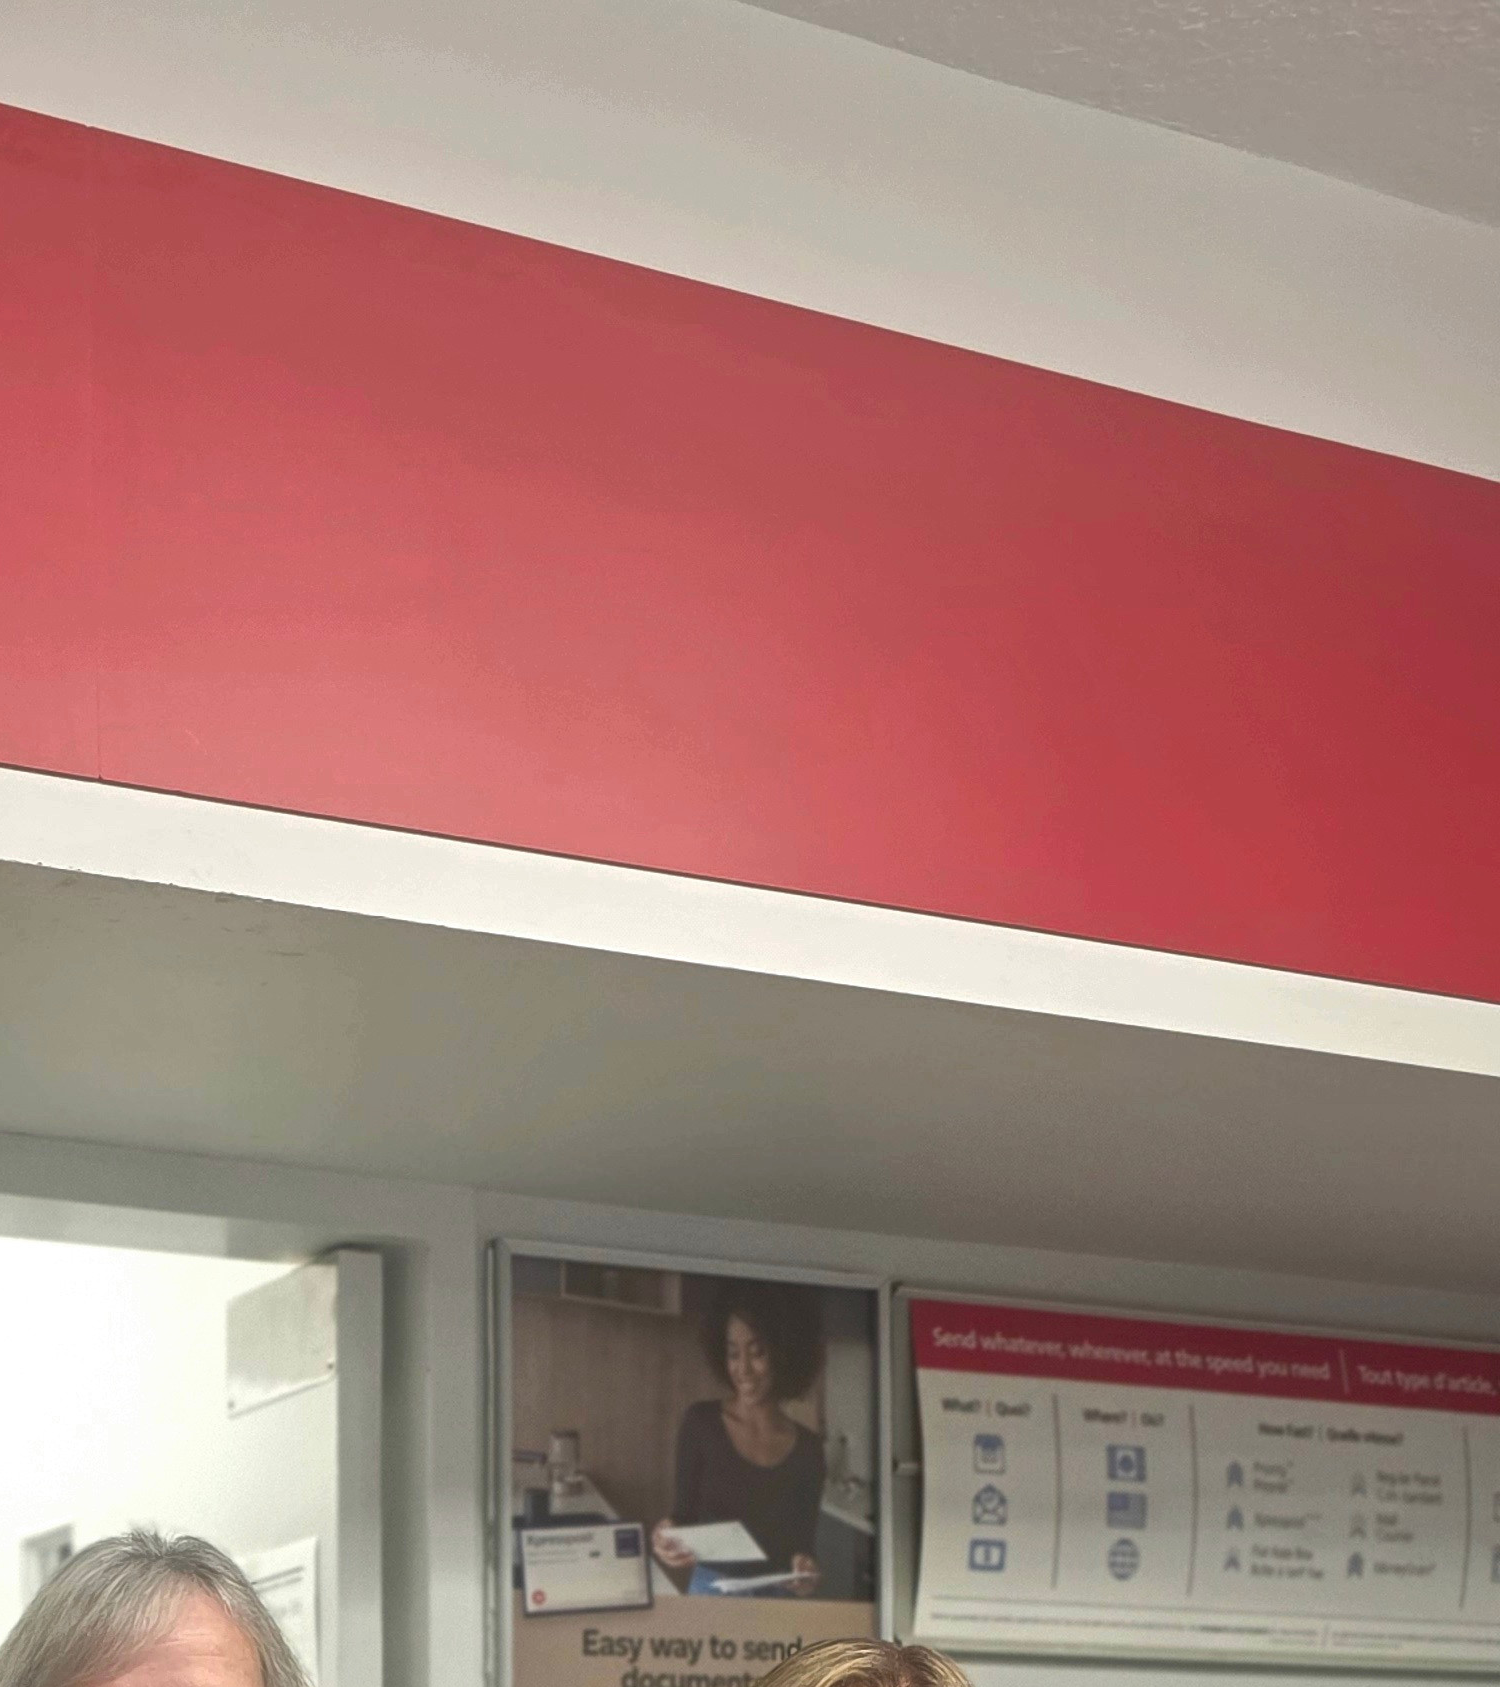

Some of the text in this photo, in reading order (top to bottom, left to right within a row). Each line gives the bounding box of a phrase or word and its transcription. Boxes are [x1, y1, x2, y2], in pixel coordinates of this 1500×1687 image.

[933, 1327, 1330, 1380] Send whatever, wherever, at the speed you need
[1358, 1365, 1393, 1386] Tout
[1397, 1370, 1430, 1391] type
[582, 1628, 802, 1666] Easy way to send
